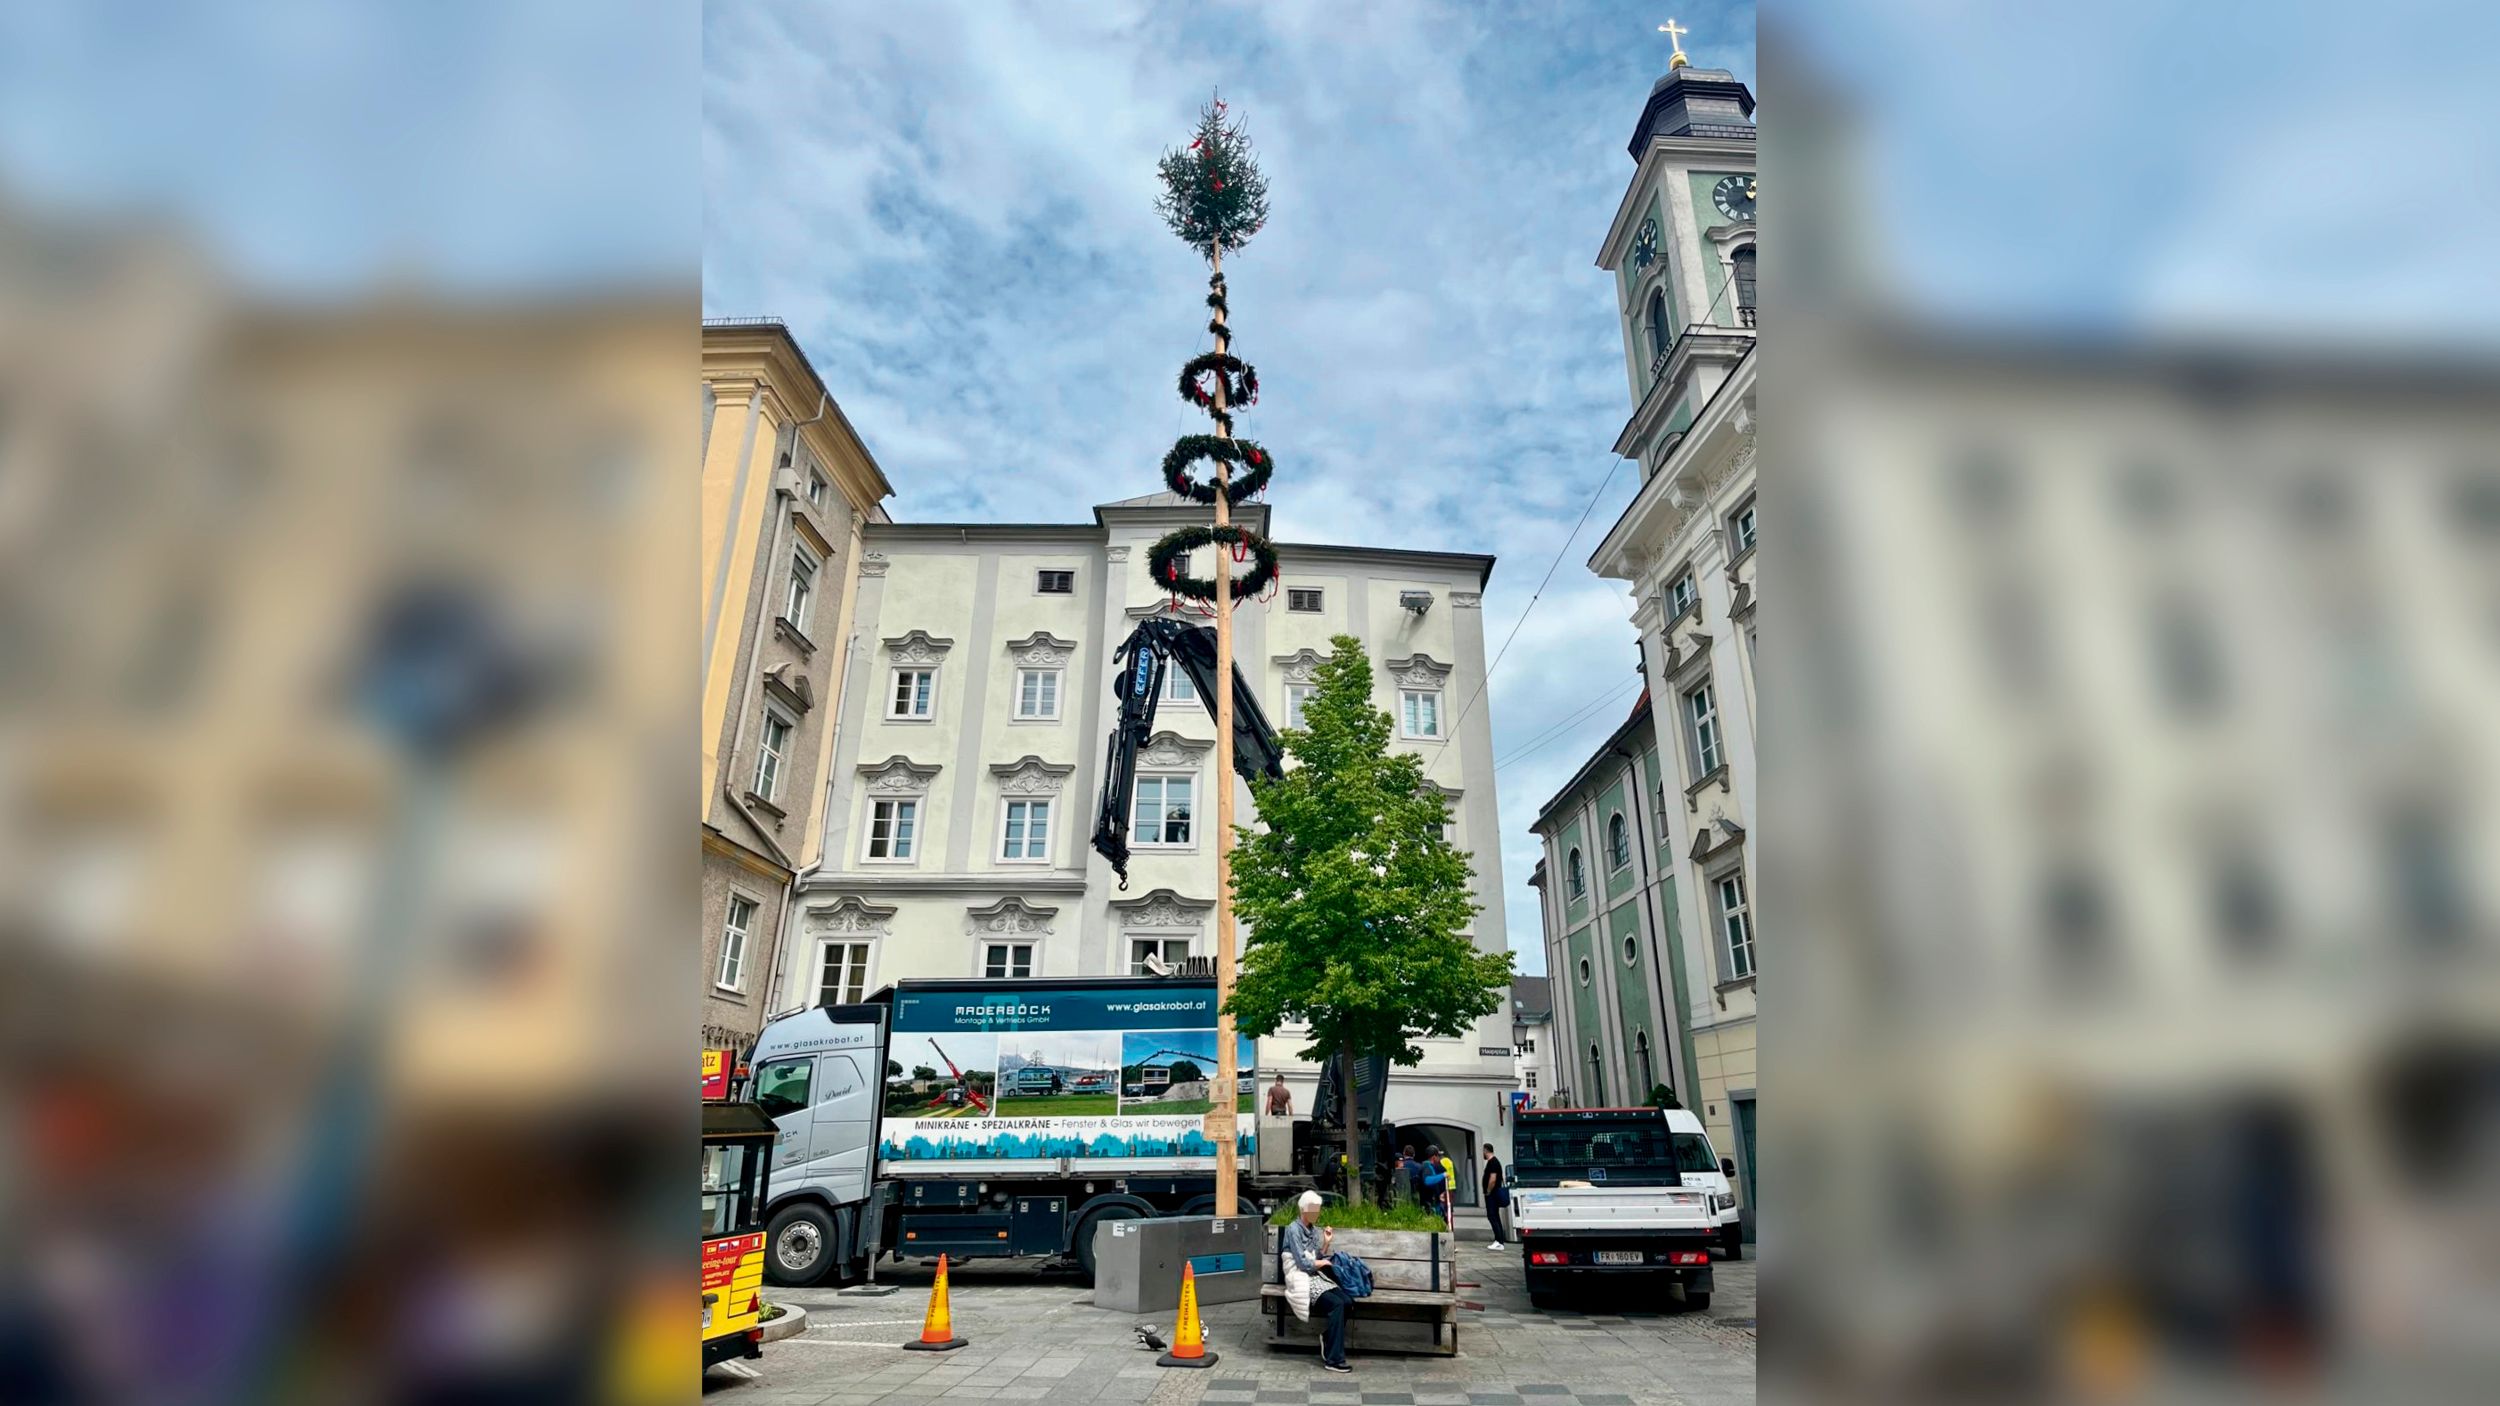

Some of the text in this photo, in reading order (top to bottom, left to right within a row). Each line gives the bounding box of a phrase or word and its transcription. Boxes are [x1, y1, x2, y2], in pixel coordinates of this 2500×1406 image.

[1136, 649, 1149, 692] EFFER
[955, 1004, 1050, 1016] MADERBÖCK
[1106, 1001, 1206, 1013] www.glasakrobat.at
[954, 1016, 986, 1025] Montage
[996, 1016, 1026, 1024] Vertriebs
[770, 1035, 863, 1050] www.glasakrobat.at
[825, 1085, 852, 1100] David
[915, 1119, 970, 1130] MINIKRÄNE
[981, 1118, 1051, 1129] SPEZIALKRÄNE
[1061, 1119, 1097, 1128] Fenster
[1100, 1119, 1107, 1127] &
[1111, 1118, 1133, 1127] Glas
[1136, 1118, 1150, 1127] wir
[1152, 1118, 1201, 1128] bewegen
[1600, 1252, 1610, 1261] FR
